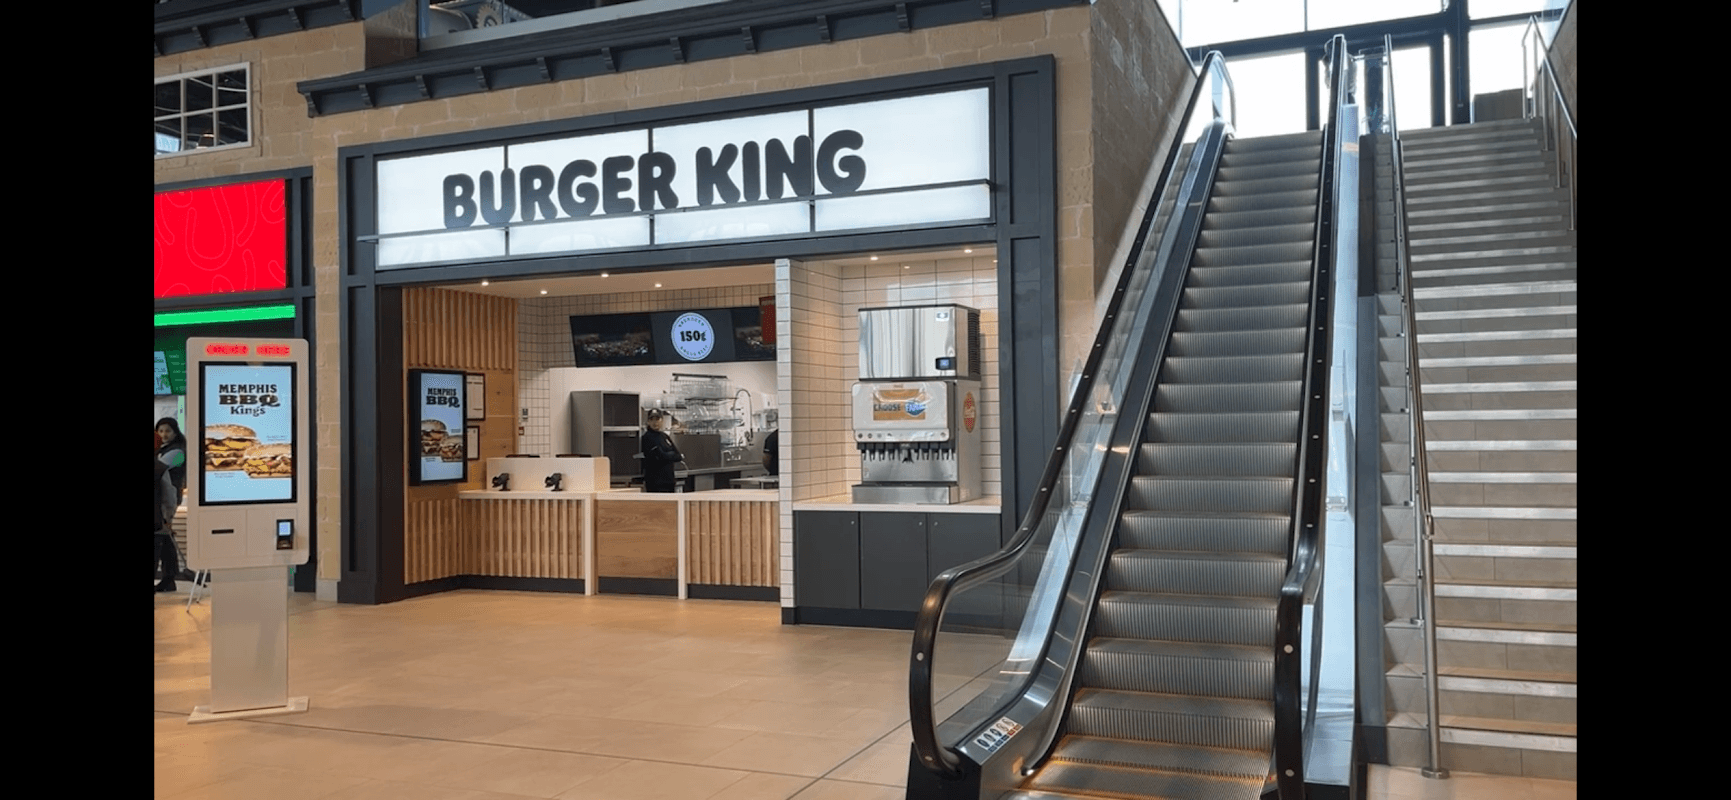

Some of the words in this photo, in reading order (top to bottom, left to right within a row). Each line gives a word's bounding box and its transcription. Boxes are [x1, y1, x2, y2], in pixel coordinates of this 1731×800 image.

[443, 151, 679, 229] BURGER
[695, 129, 867, 206] KING
[219, 384, 277, 394] MEMPHIS
[427, 387, 457, 397] MEMPHIS
[219, 394, 281, 408] BBQ
[426, 396, 460, 408] BBQ
[230, 405, 267, 418] Kings
